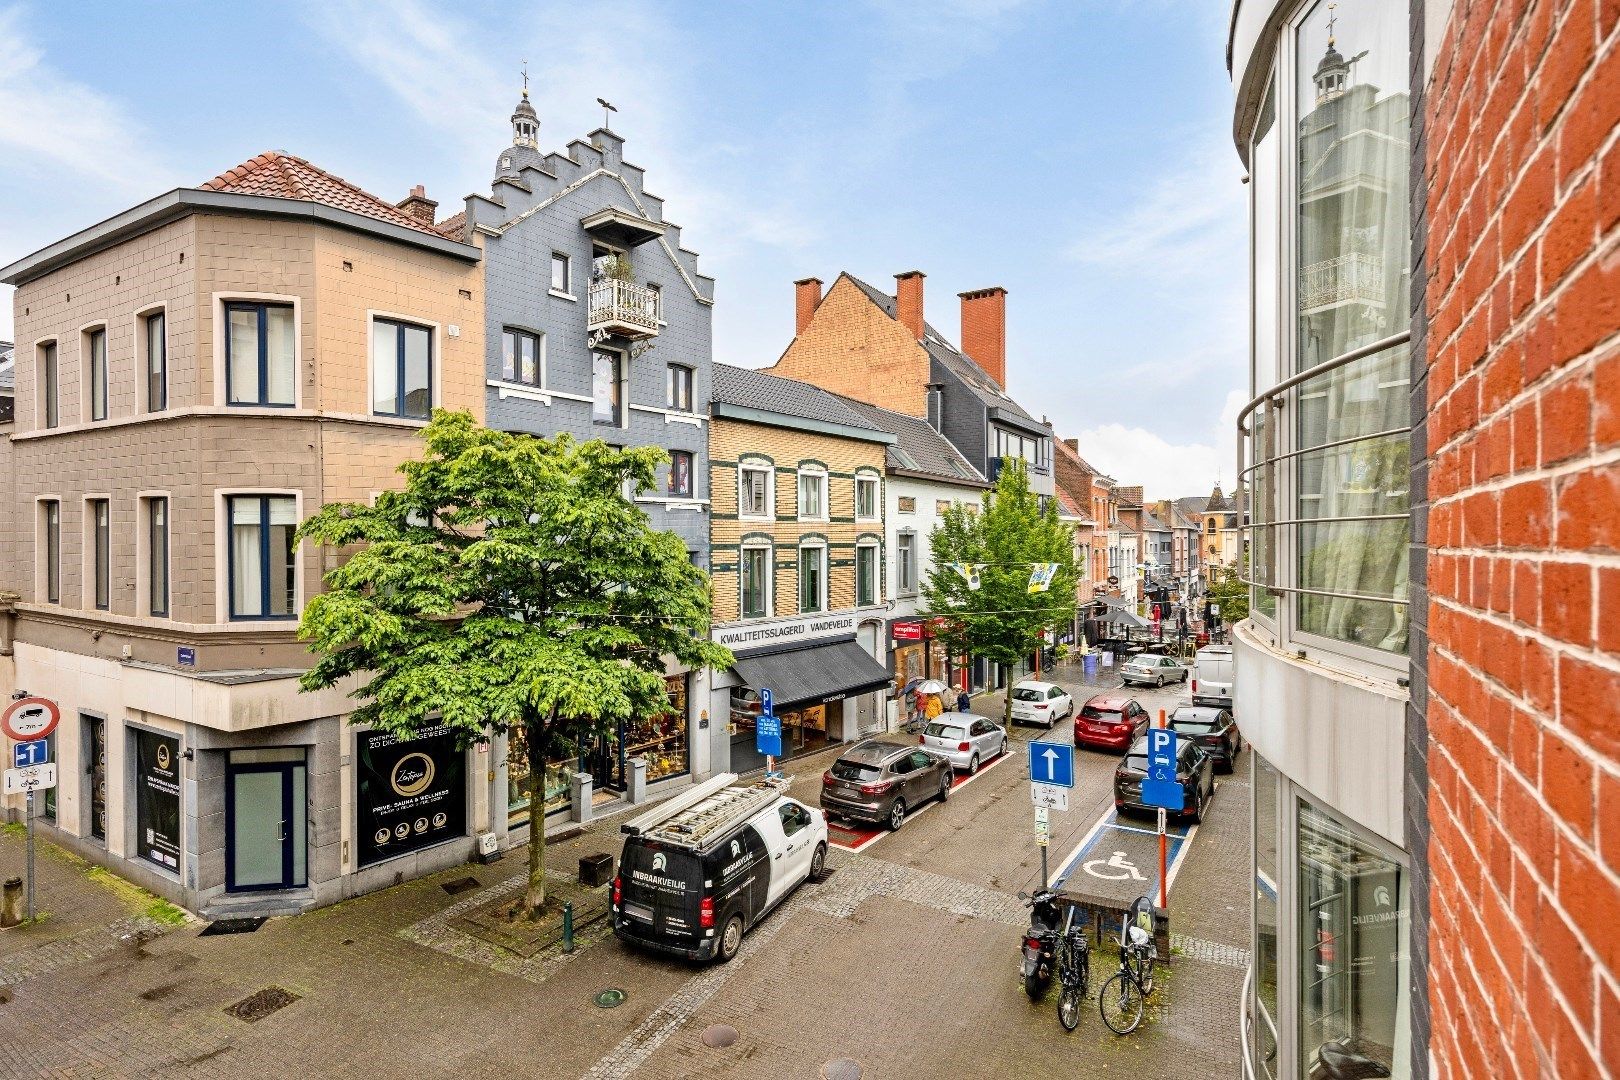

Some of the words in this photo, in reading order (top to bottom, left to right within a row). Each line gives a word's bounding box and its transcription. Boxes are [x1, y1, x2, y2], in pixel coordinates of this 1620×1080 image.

[720, 624, 805, 645] KWALITEITSSLAGERIJ
[810, 618, 853, 632] VANDEVELDE
[894, 626, 919, 634] amplifon
[763, 690, 769, 705] P
[369, 741, 381, 749] ZO
[1154, 731, 1170, 752] P
[393, 798, 414, 808] SAUNA
[419, 789, 449, 800] WELLNESS
[632, 869, 686, 890] INBRAAKVEILIG
